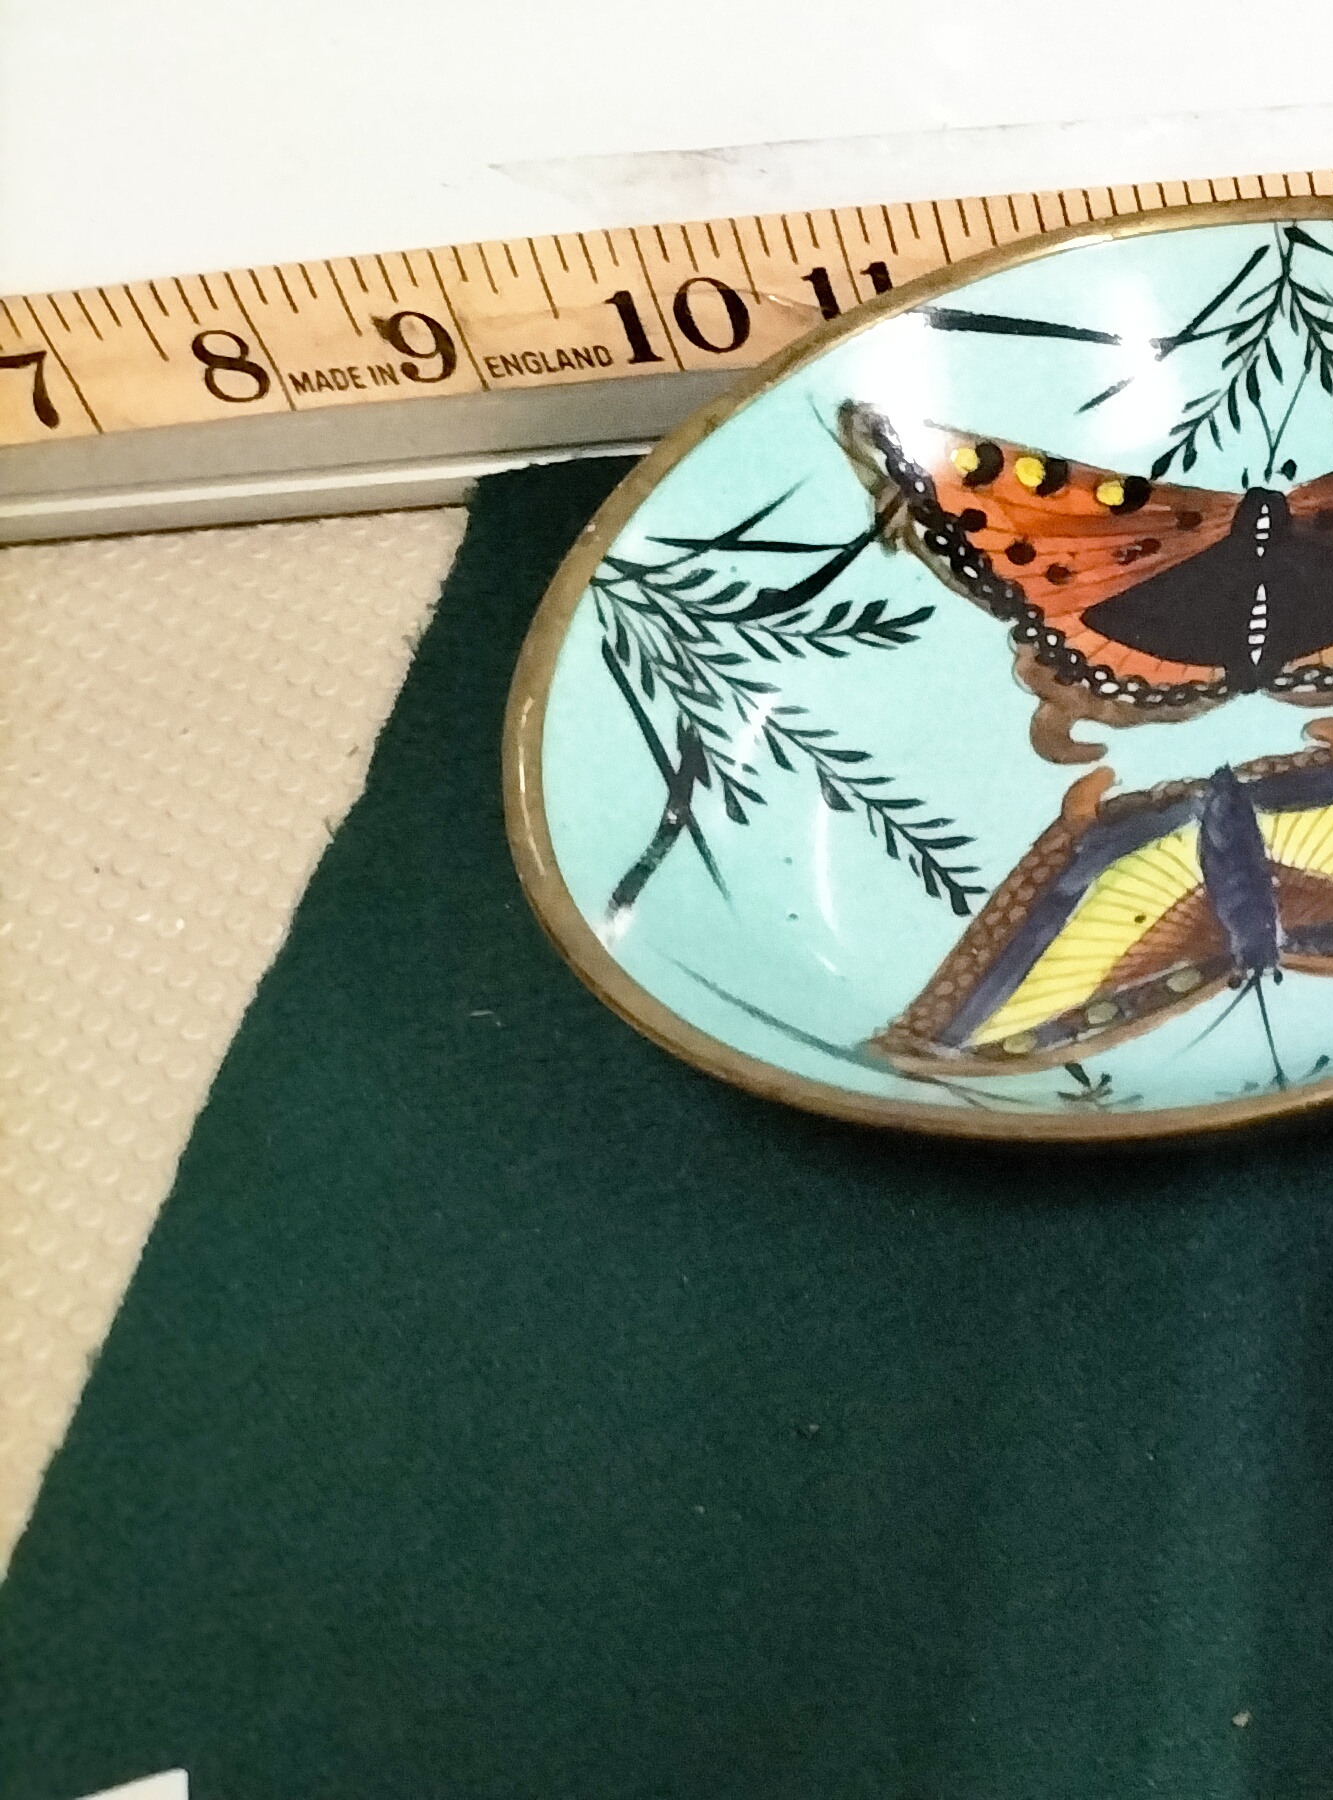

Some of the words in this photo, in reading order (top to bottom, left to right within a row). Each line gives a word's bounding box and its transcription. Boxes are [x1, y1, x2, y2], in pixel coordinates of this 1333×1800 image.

[191, 329, 271, 403] 8
[372, 311, 457, 383] 9
[605, 277, 750, 364] 10
[289, 366, 367, 395] MADE
[366, 362, 400, 387] IN
[483, 345, 613, 379] ENGLAND
